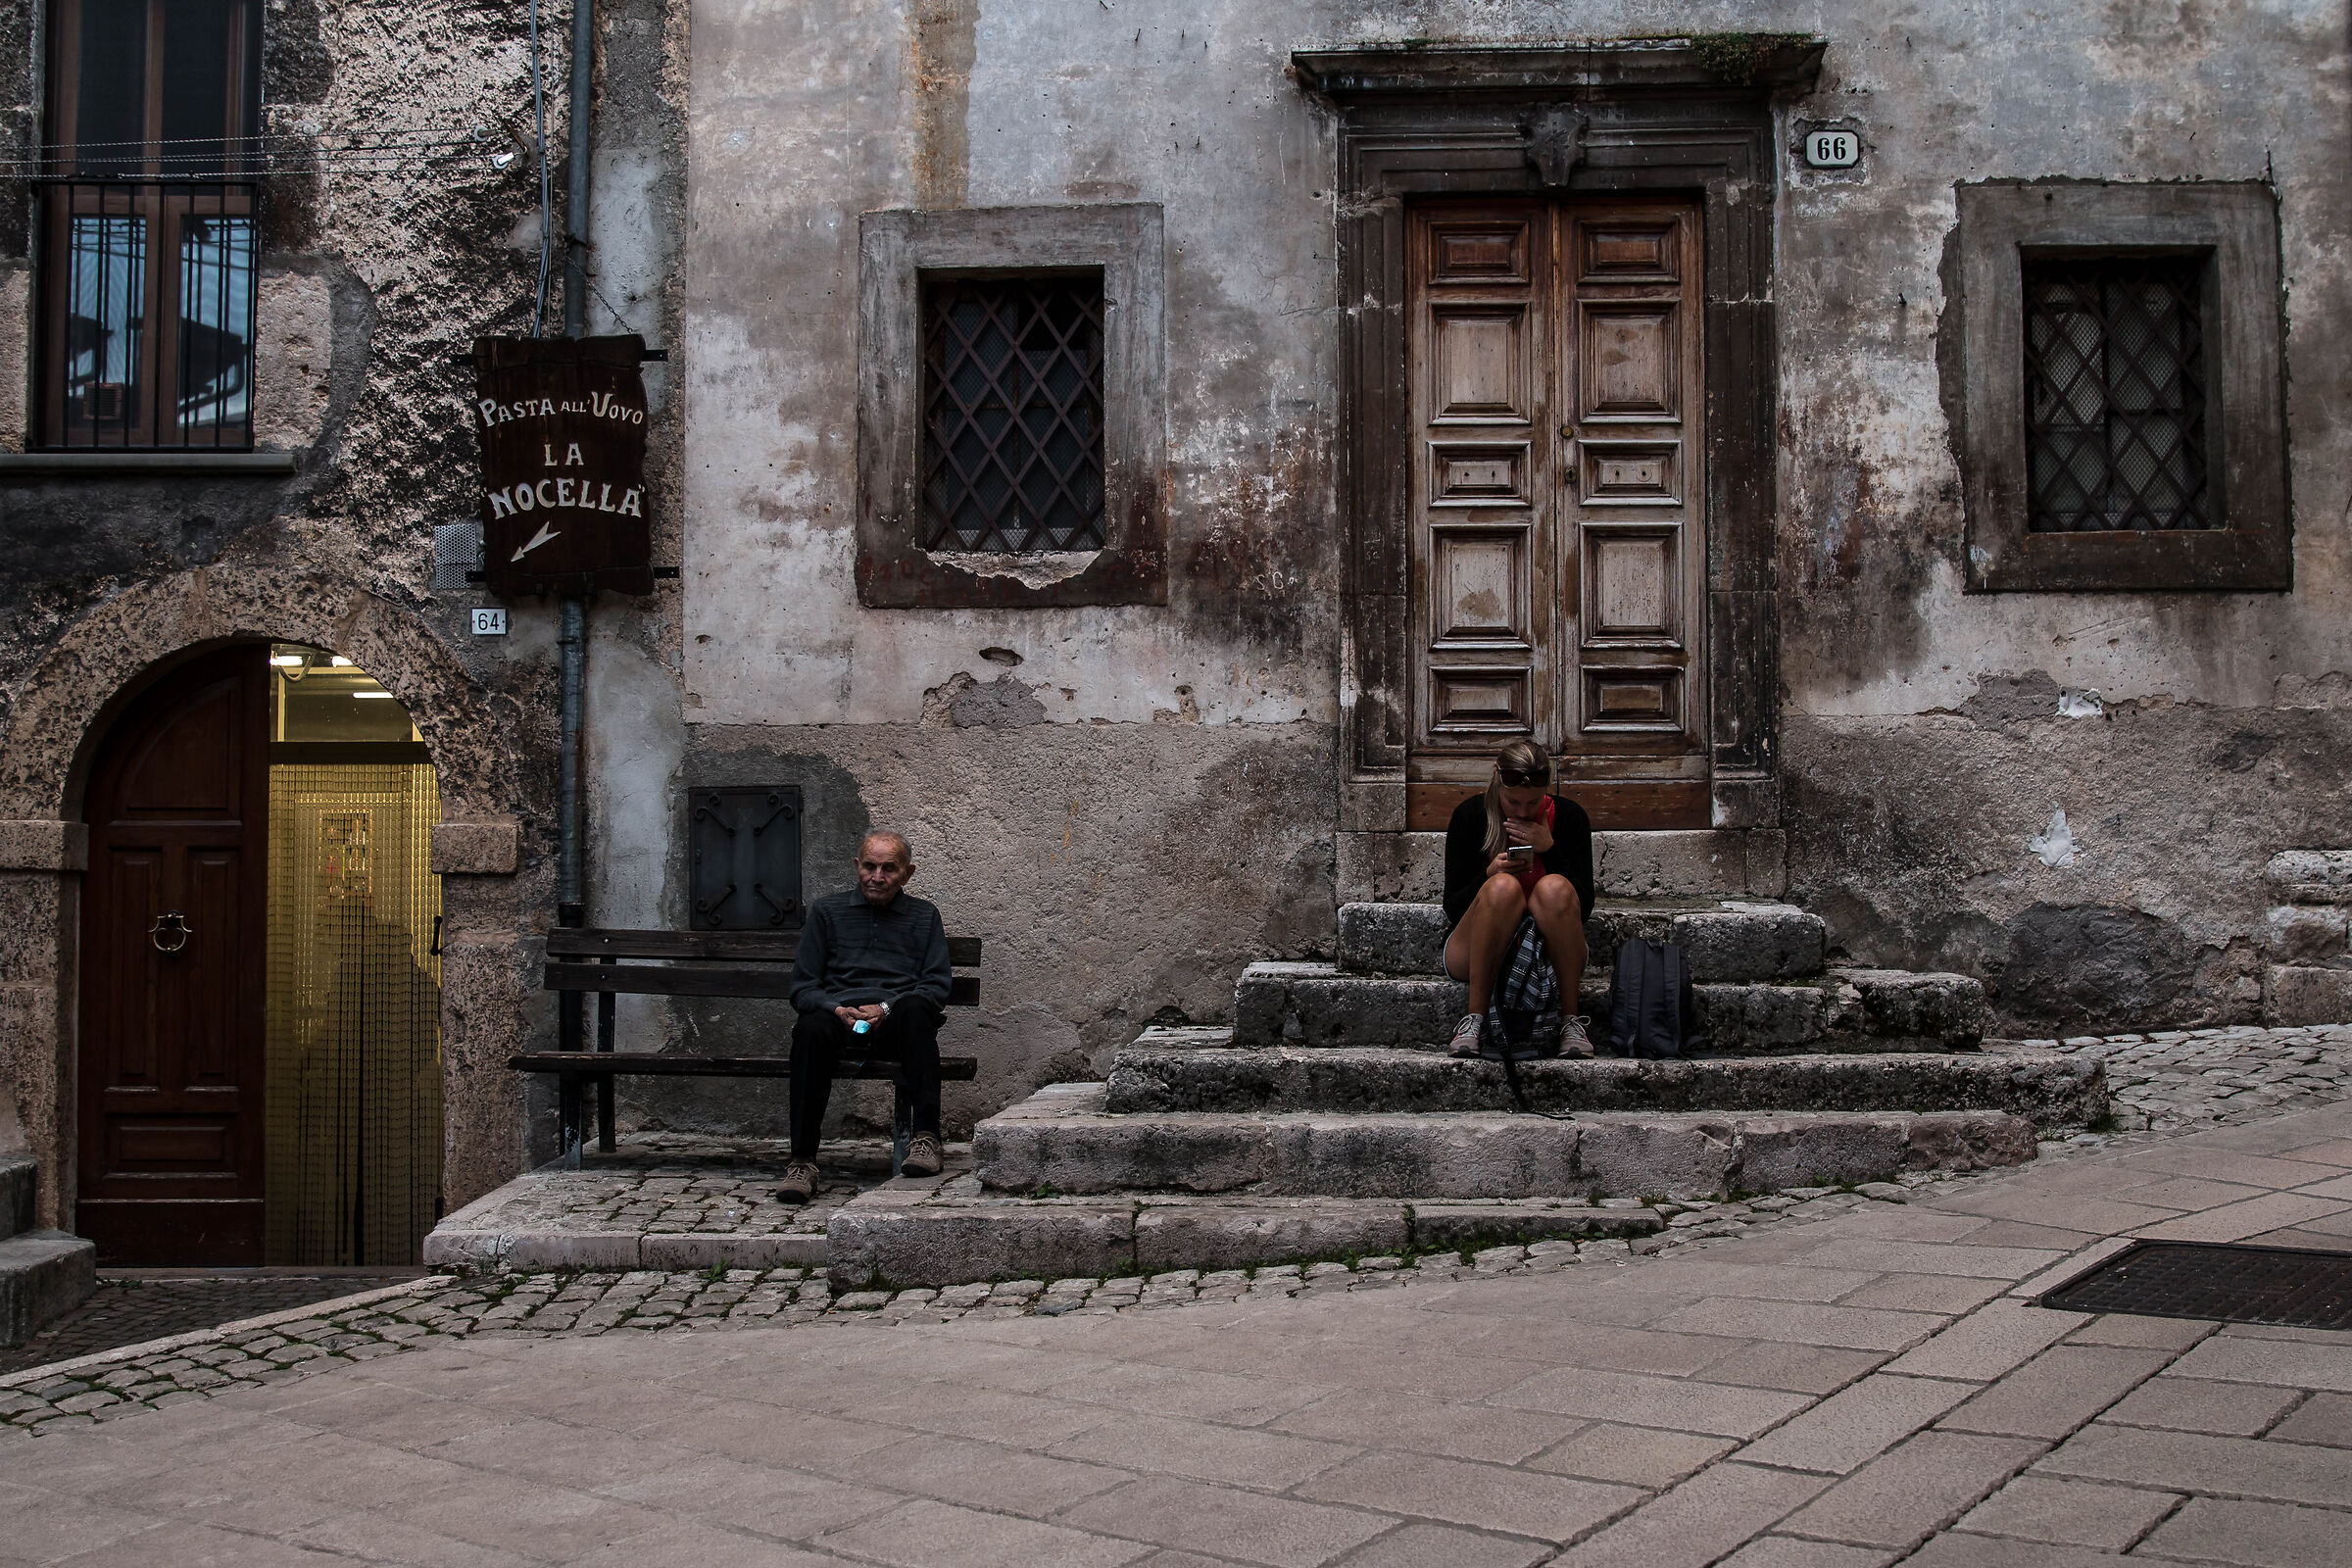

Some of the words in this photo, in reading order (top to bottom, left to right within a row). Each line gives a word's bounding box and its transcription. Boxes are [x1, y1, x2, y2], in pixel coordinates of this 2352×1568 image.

[1817, 137, 1846, 161] 66
[478, 398, 556, 426] PASTA
[544, 442, 584, 466] LA
[478, 612, 500, 631] 64
